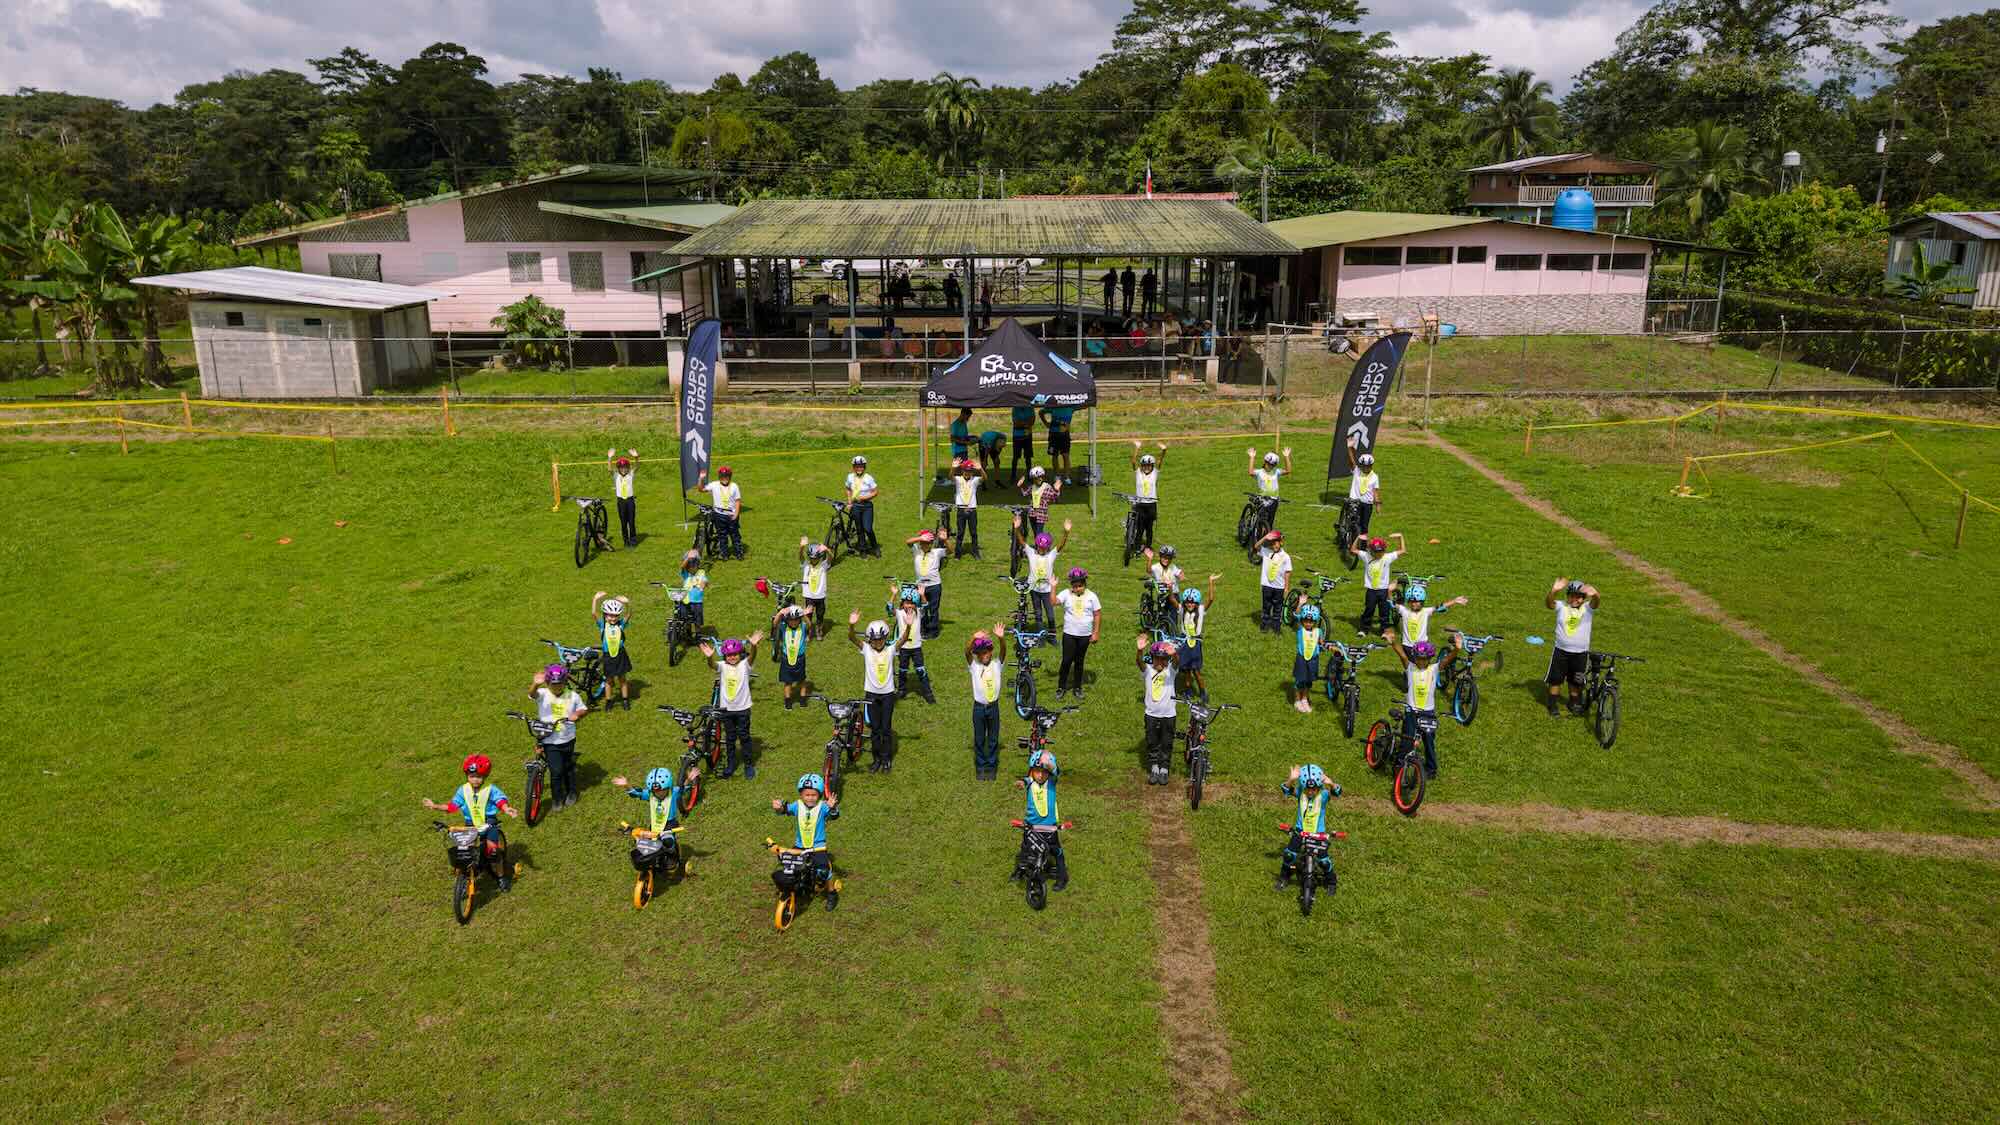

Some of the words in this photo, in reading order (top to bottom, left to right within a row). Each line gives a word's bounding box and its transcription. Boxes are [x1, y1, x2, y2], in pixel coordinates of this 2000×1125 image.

[687, 357, 699, 422] GRUPO
[695, 360, 708, 425] PURDY
[979, 372, 1038, 385] IMPULSO
[1012, 360, 1034, 372] YO
[1352, 362, 1378, 417] GRUPO
[1362, 362, 1389, 417] PURDY
